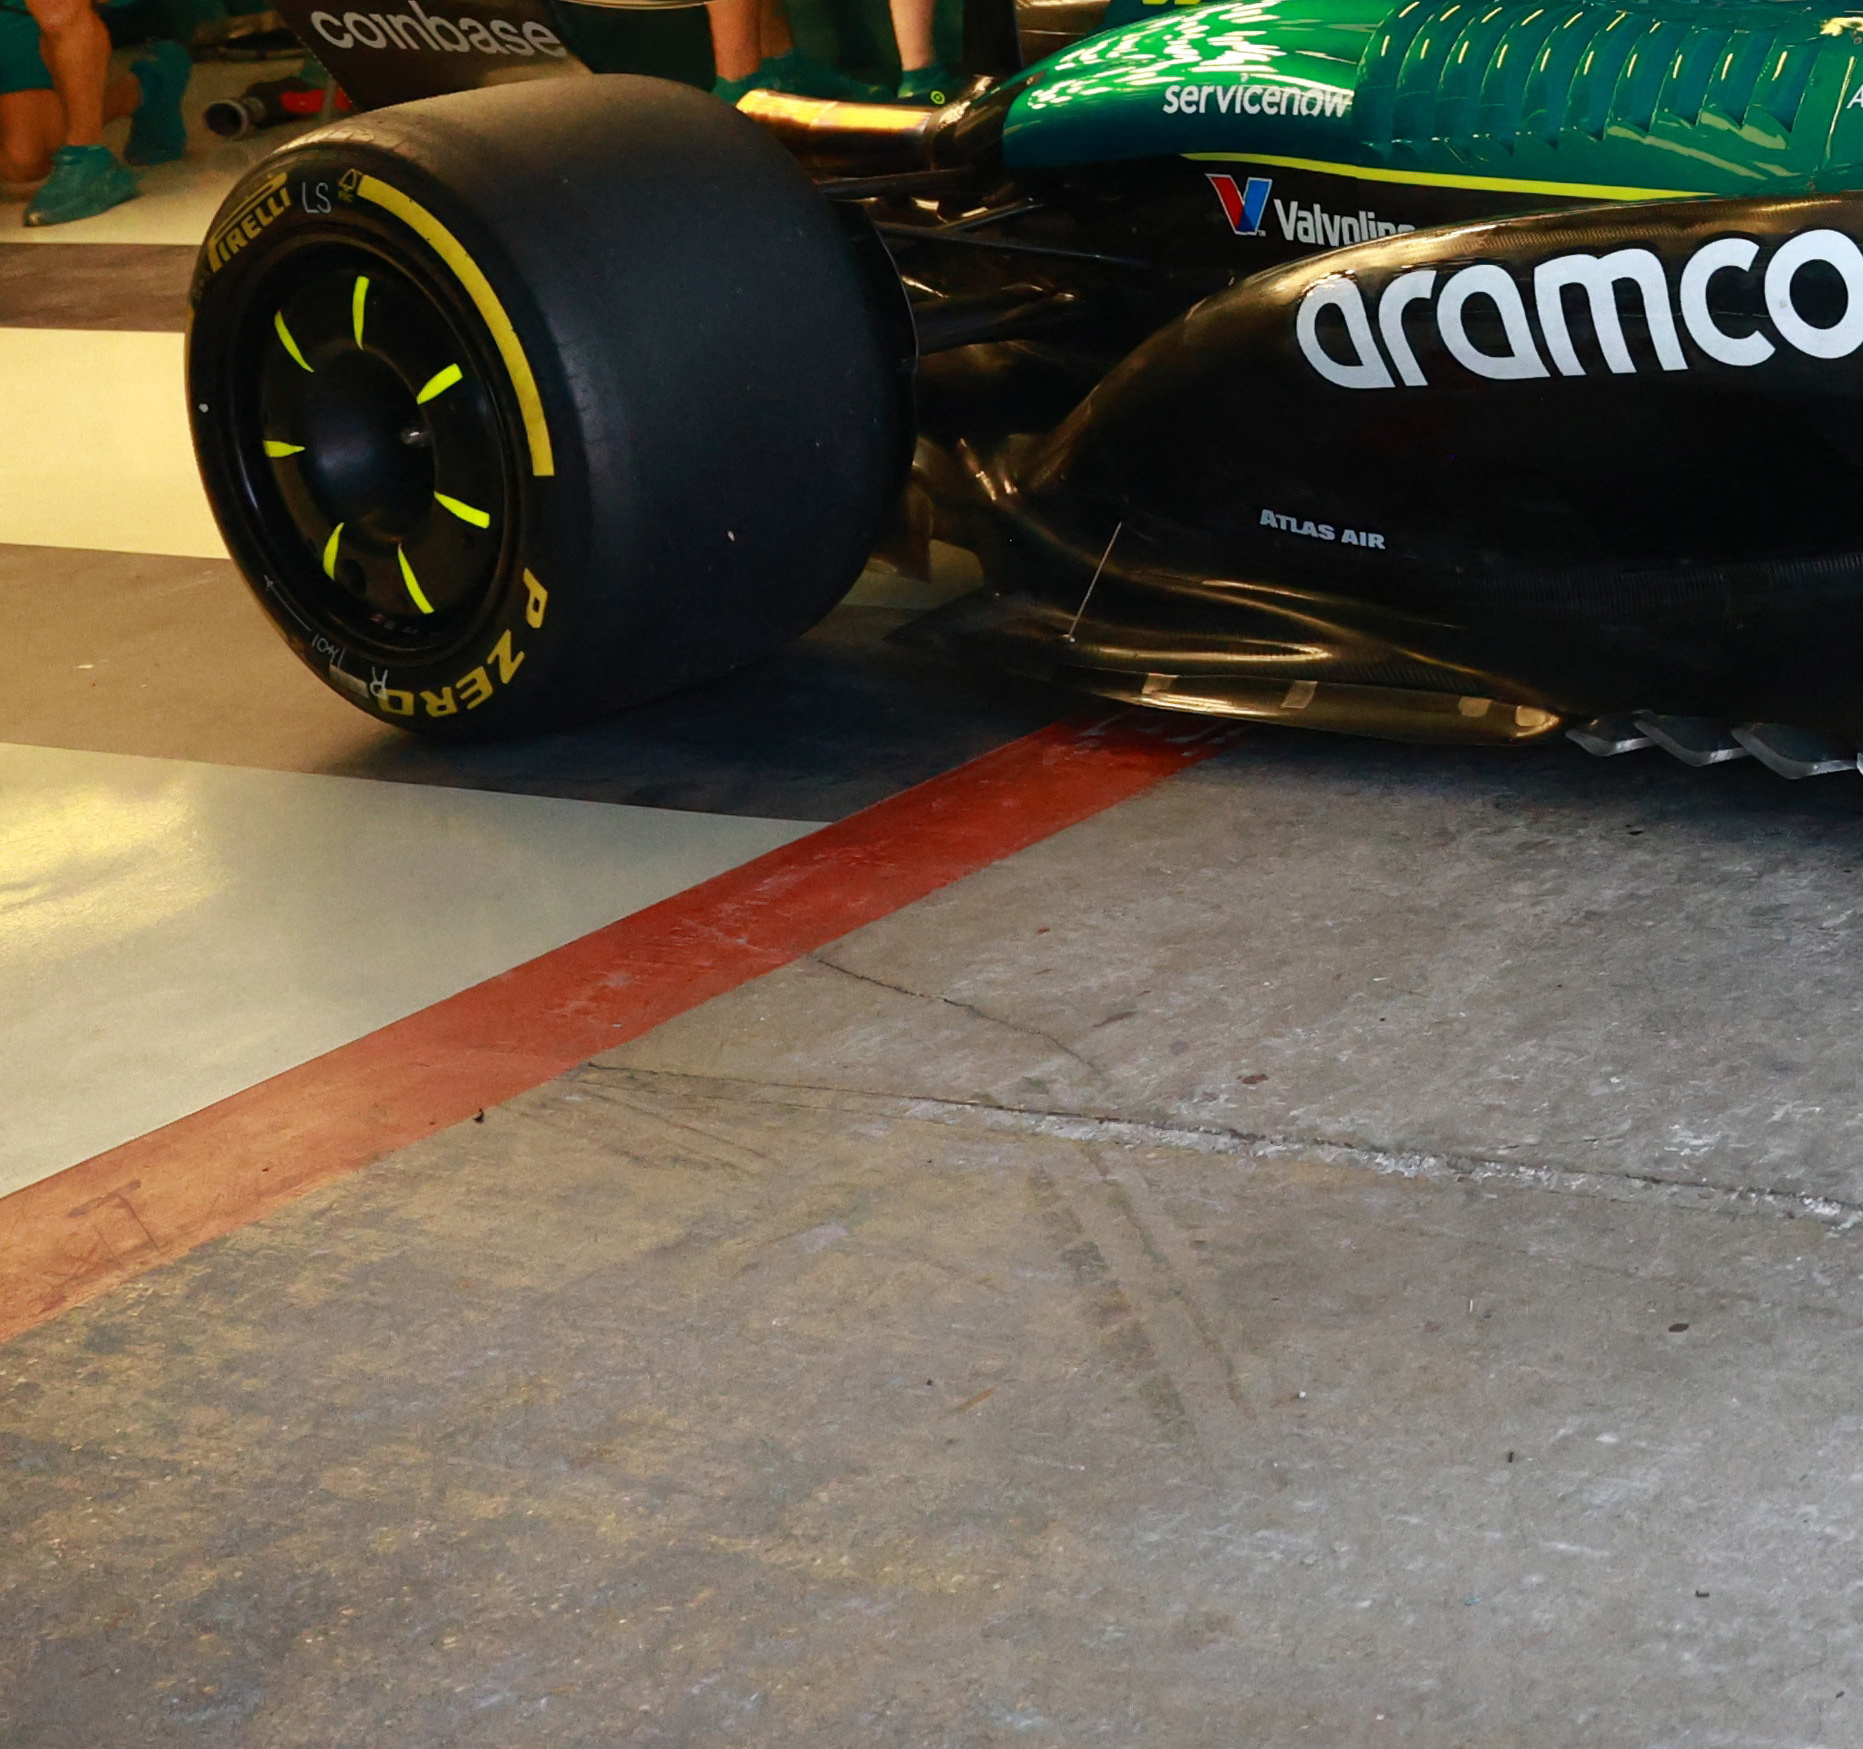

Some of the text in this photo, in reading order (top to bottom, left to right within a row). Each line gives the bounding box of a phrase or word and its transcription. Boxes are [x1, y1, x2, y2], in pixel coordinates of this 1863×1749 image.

[309, 0, 568, 56] coinbase
[1162, 73, 1352, 119] servicenow
[207, 172, 292, 273] PIRELLI
[302, 181, 332, 214] LS
[1259, 508, 1386, 551] ATLAS AIR
[377, 567, 549, 718] P ZERO
